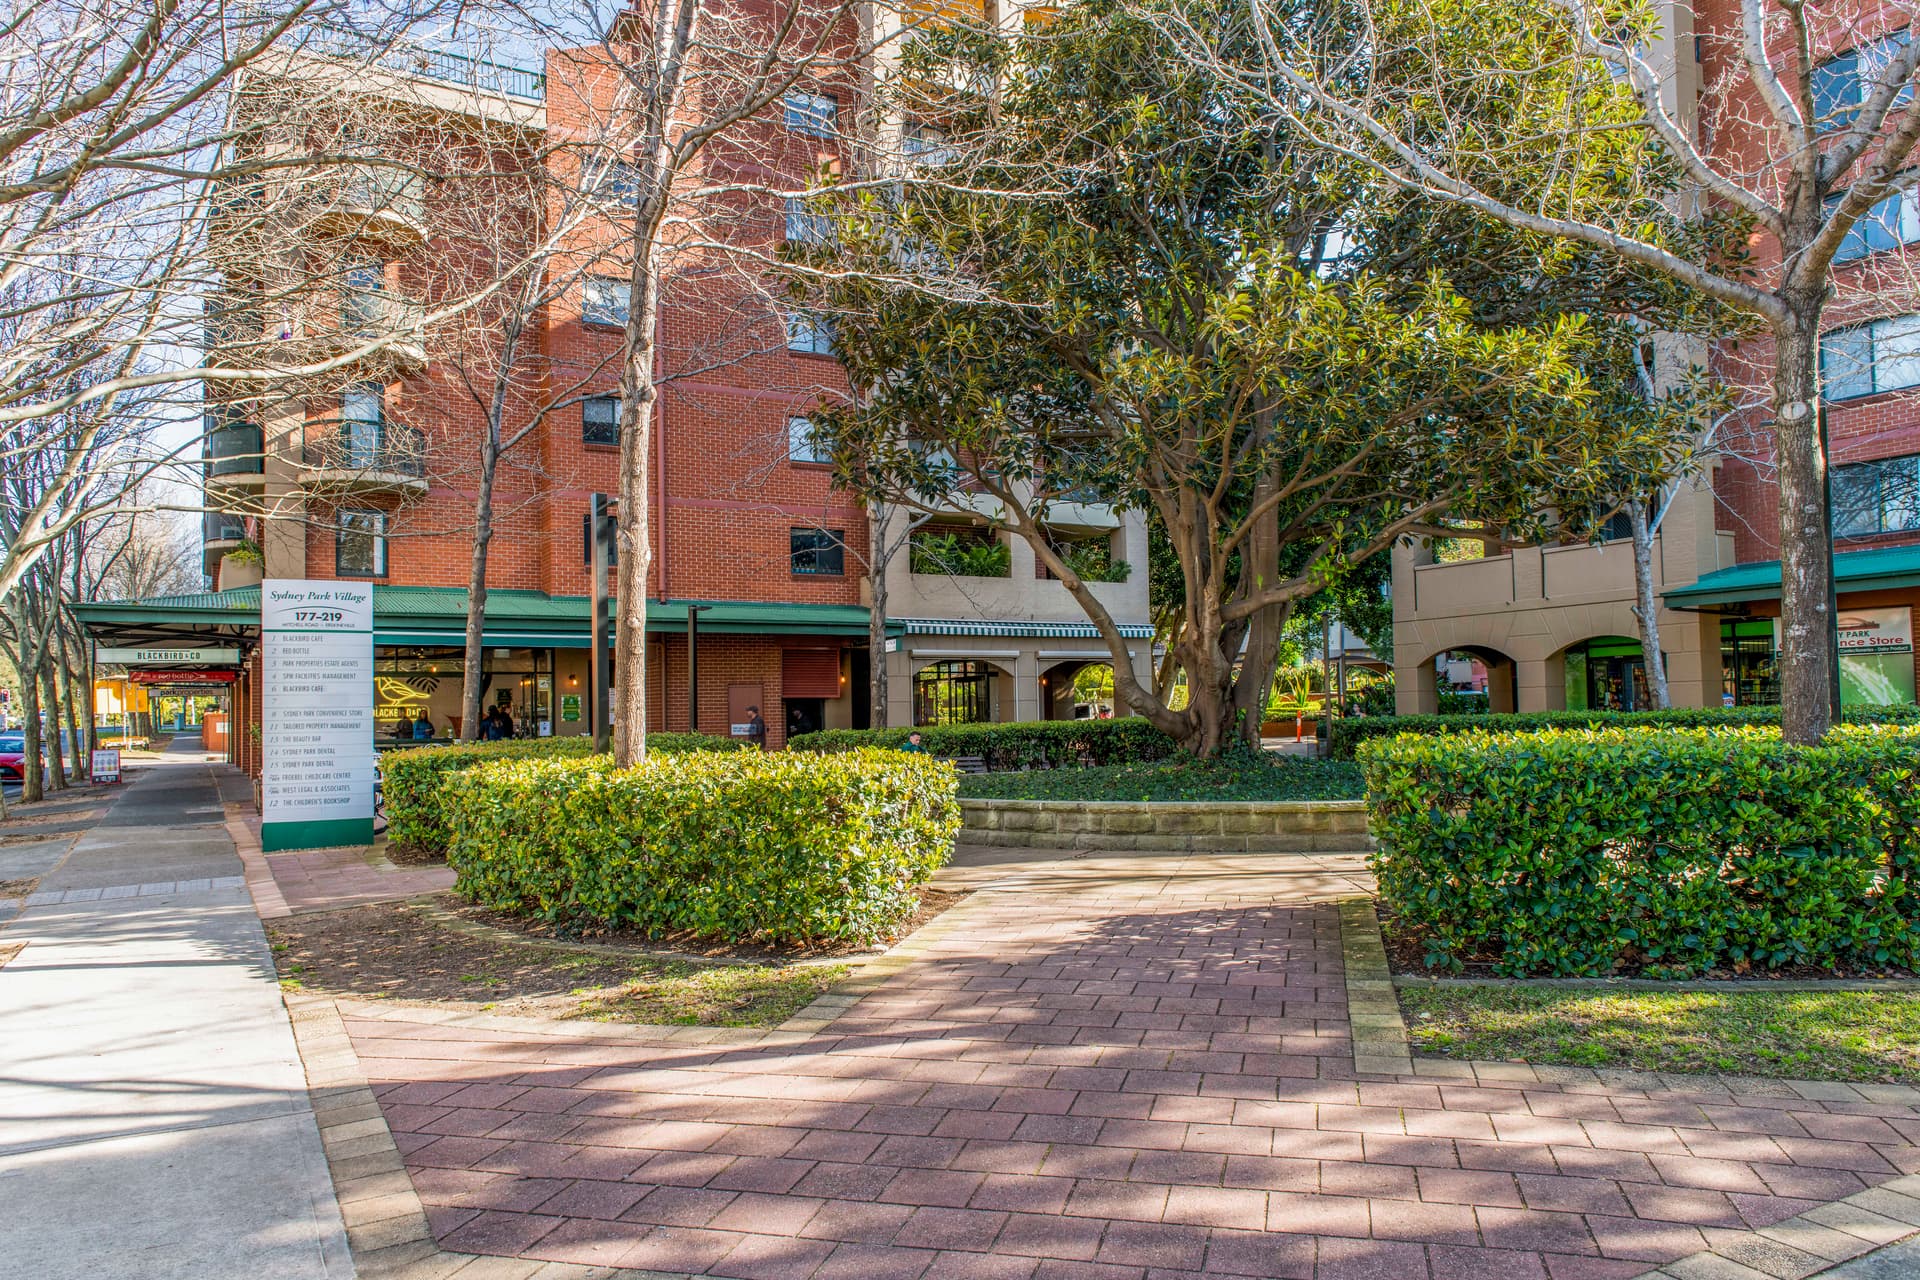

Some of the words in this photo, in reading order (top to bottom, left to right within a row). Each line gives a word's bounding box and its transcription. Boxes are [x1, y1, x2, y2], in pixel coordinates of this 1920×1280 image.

[270, 590, 304, 602] Sydney
[308, 592, 331, 600] Park
[334, 592, 366, 603] Village
[296, 612, 342, 622] 177-219
[1869, 637, 1904, 645] Store
